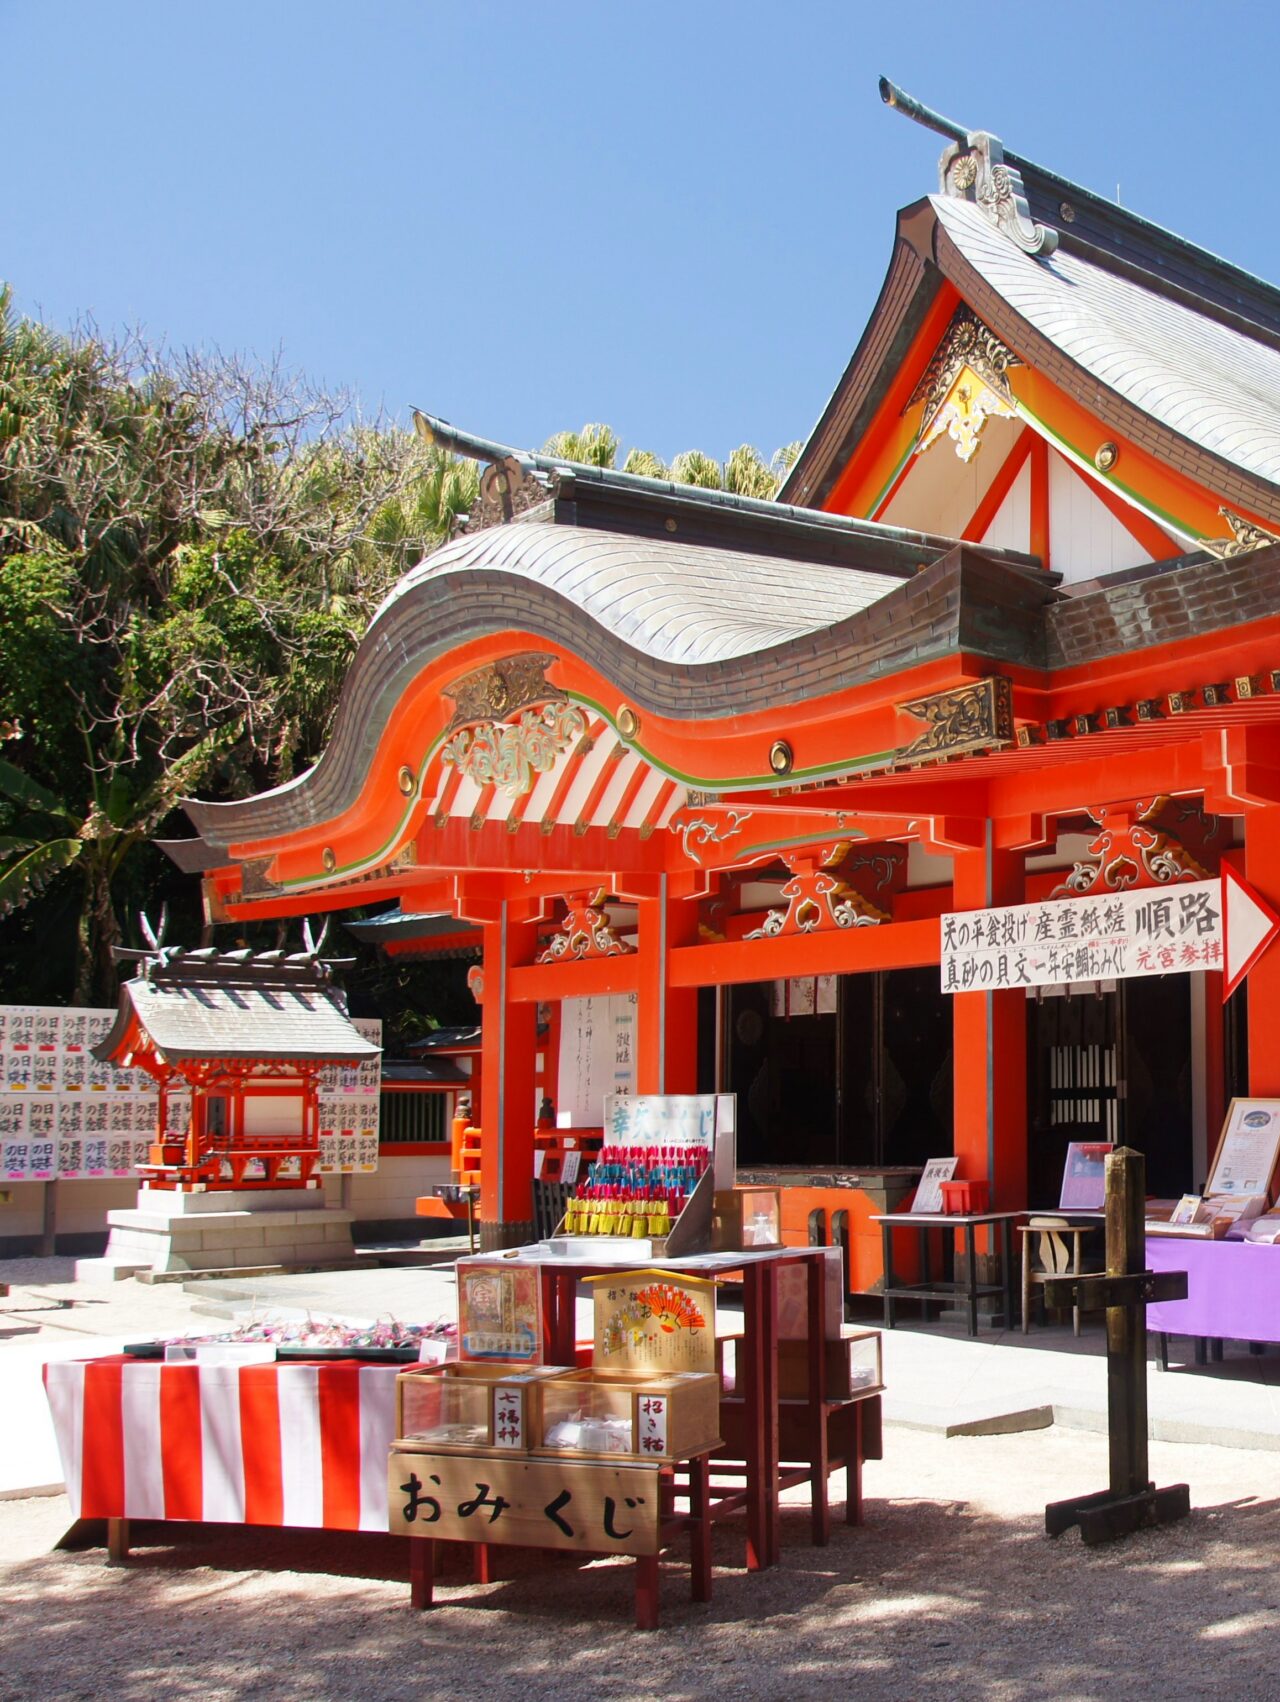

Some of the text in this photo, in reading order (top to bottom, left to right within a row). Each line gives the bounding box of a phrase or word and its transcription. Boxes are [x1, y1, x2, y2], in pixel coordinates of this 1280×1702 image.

[1135, 892, 1220, 940] 順路
[944, 953, 1031, 991] 真砂の貝文
[1036, 945, 1128, 981] 一年安鯛おみくじ
[1136, 942, 1223, 971] 元宮参拝
[612, 1106, 713, 1141] 幸矢くじ
[641, 1305, 699, 1336] おみくじ
[498, 1392, 520, 1444] 七福神
[642, 1398, 664, 1453] 招き猫
[400, 1472, 646, 1540] おみくじ
